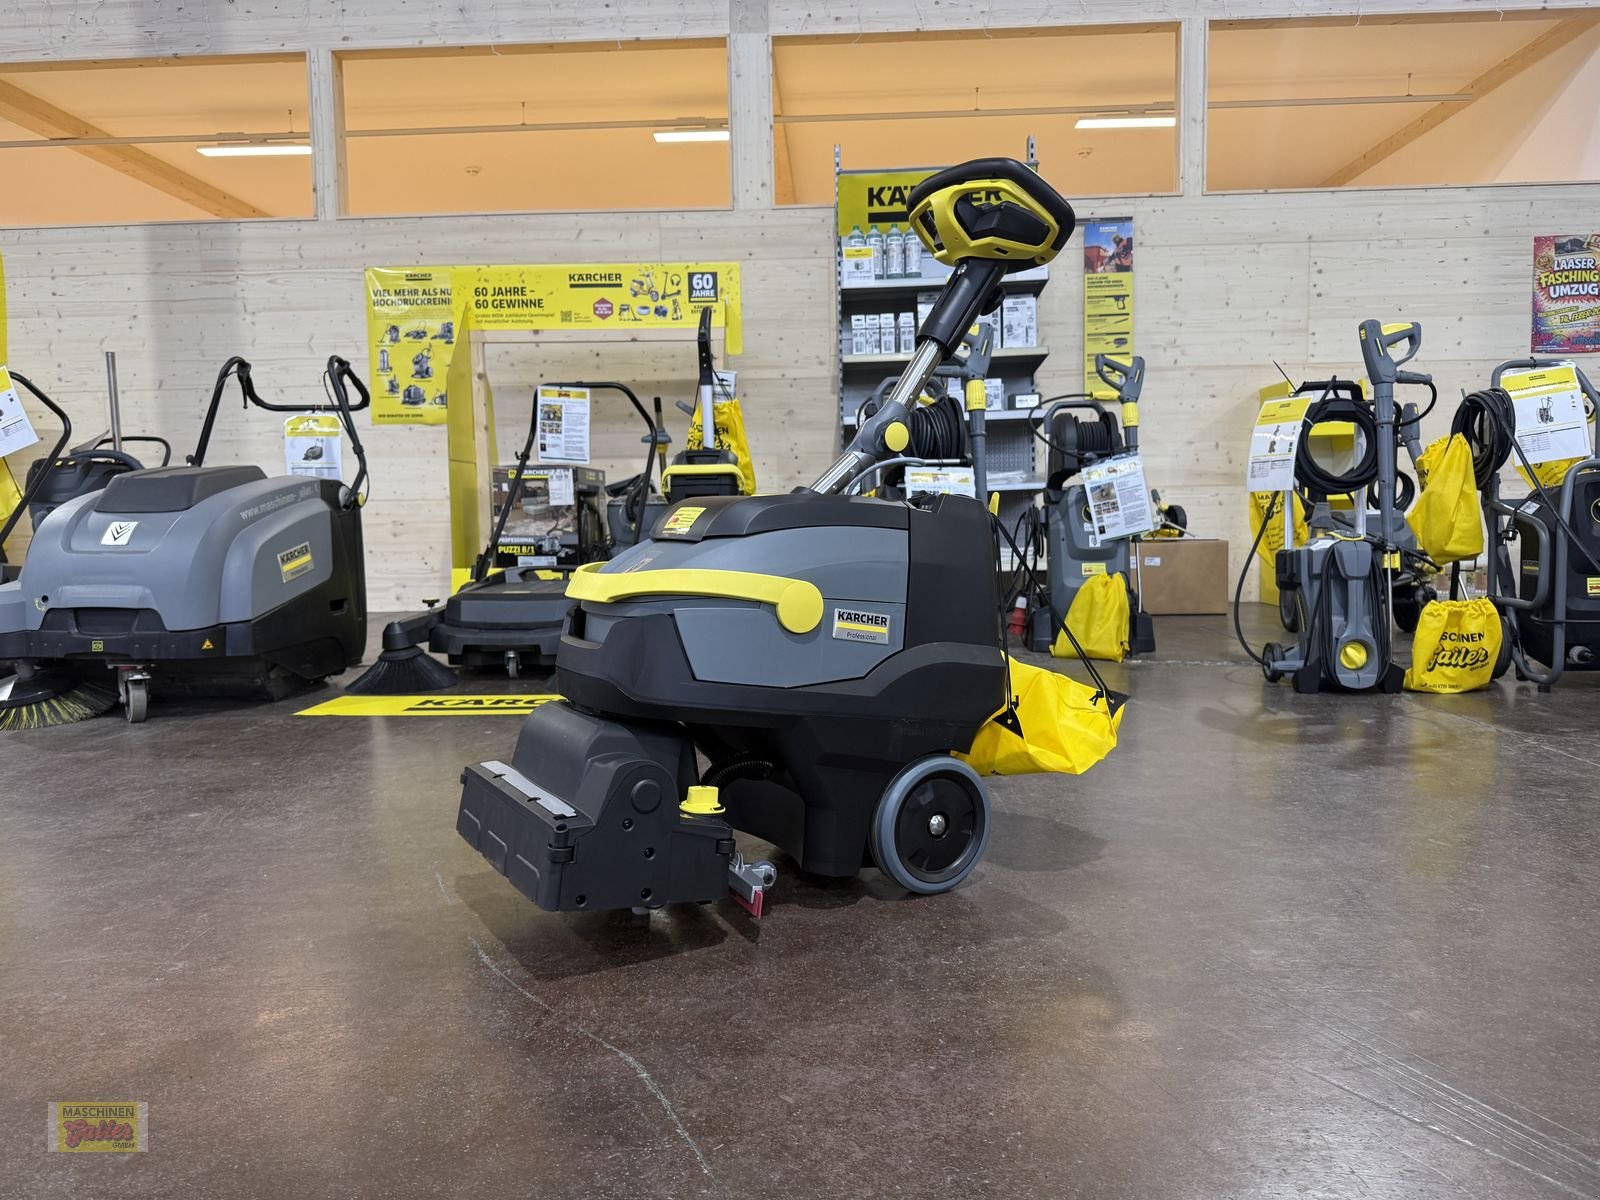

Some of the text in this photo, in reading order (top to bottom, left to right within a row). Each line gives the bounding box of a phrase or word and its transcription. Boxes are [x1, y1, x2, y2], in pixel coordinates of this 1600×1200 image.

[1554, 258, 1595, 271] LAASER
[569, 273, 622, 282] KÄRCHER
[692, 273, 713, 290] 60
[373, 289, 391, 298] VIEL
[394, 288, 420, 297] MEHR
[422, 288, 438, 296] ALS
[475, 287, 488, 297] 60
[491, 286, 526, 297] JAHRE
[1549, 284, 1599, 299] UMZUG
[373, 297, 452, 307] HOCHDRUCKREINI
[475, 298, 544, 309] 60 GEWINNE
[279, 543, 310, 563] KÄRCHER
[838, 611, 887, 626] KÄRCHER
[846, 631, 877, 640] Professional
